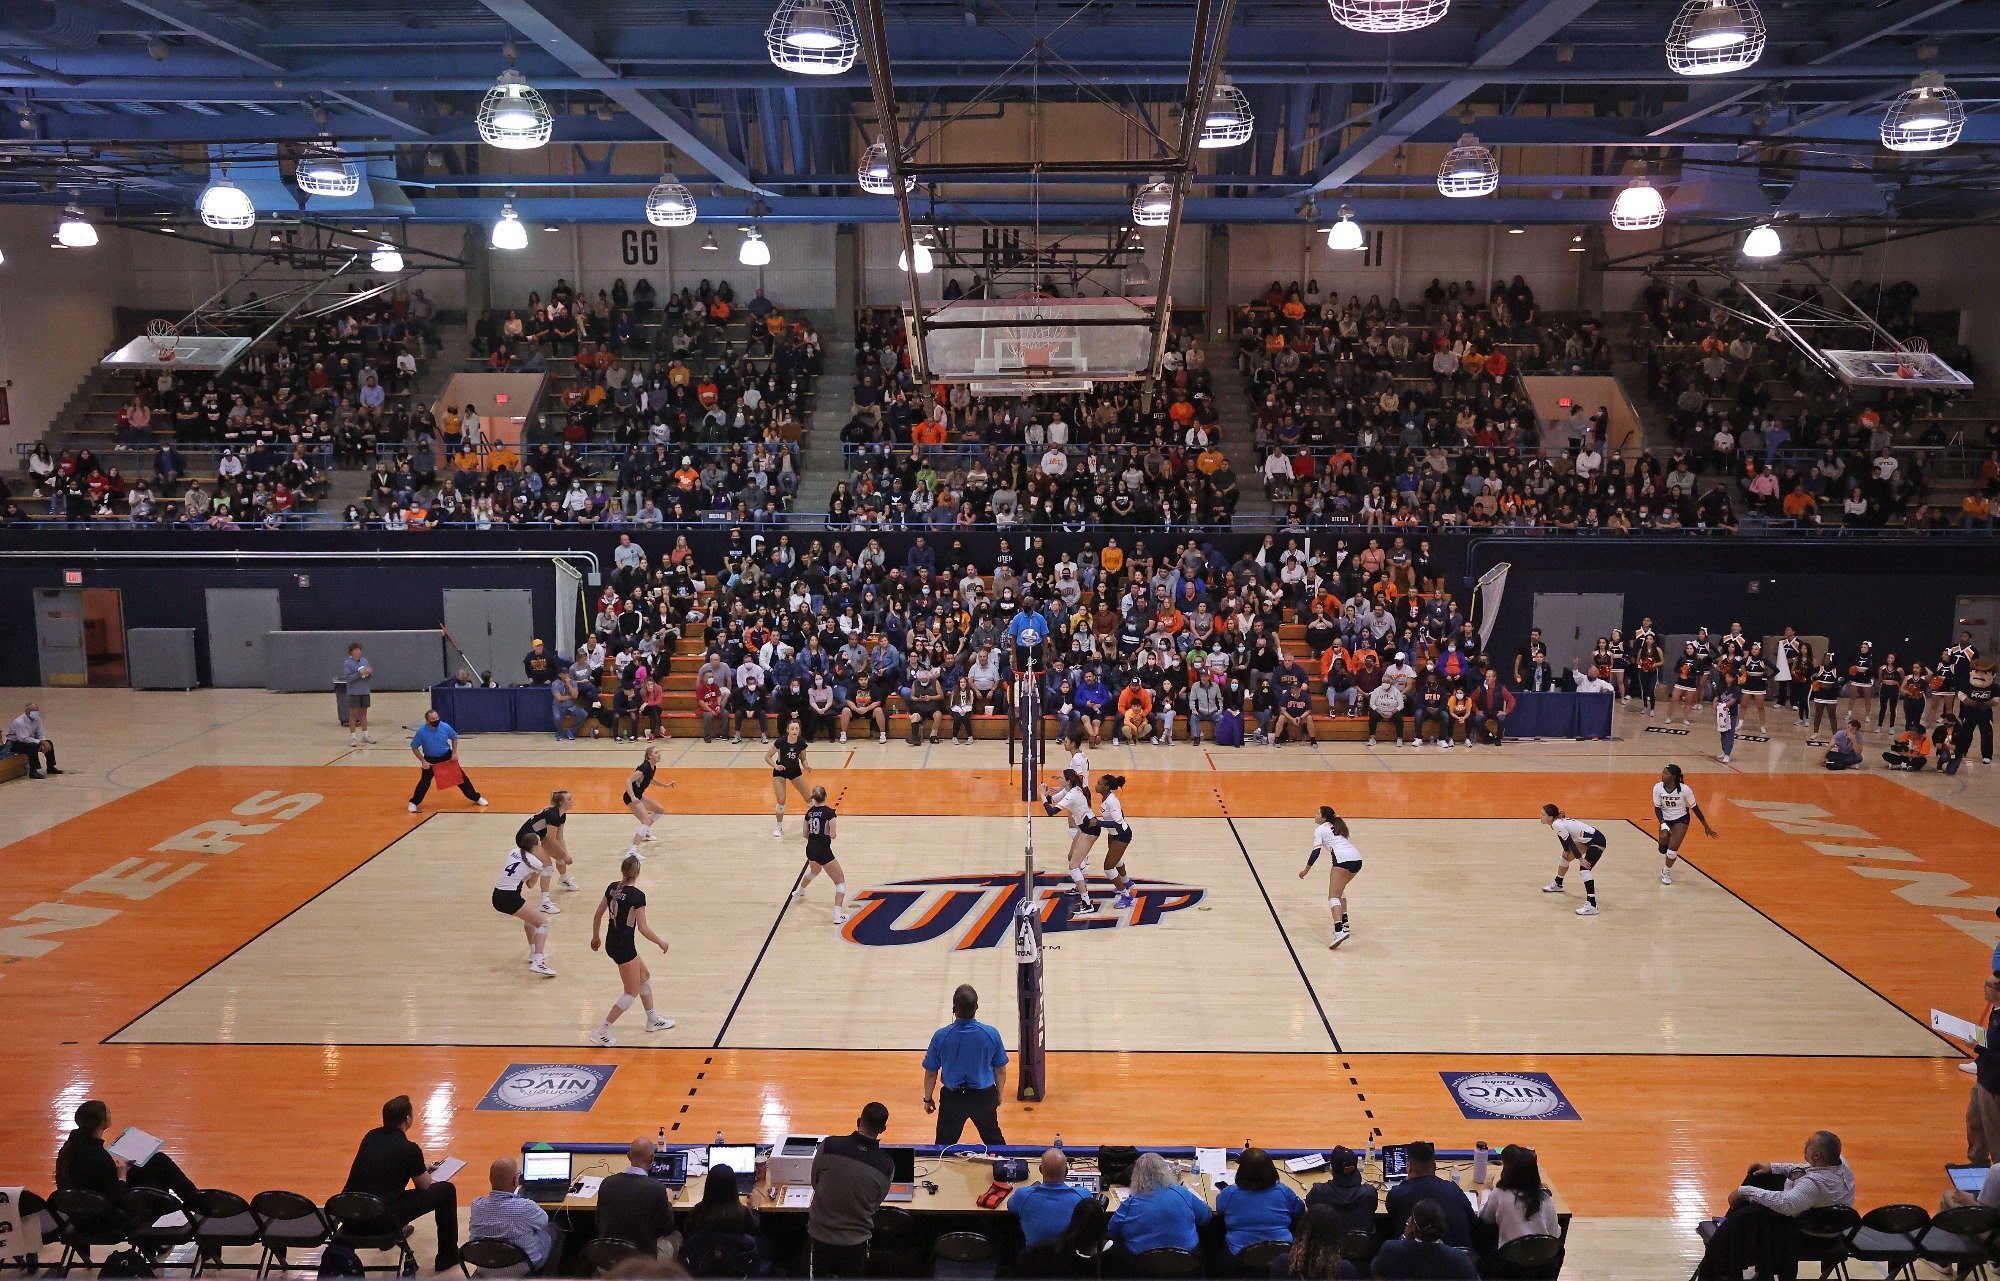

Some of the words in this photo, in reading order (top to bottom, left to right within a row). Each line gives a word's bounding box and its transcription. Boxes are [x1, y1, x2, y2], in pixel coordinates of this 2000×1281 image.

[622, 229, 658, 265] GG
[982, 228, 1023, 268] HH
[1424, 693, 1441, 701] UTEP
[786, 752, 796, 760] 15
[808, 818, 821, 834] 19
[0, 790, 324, 959] NERS
[504, 861, 521, 877] 4
[841, 871, 1206, 950] UTEP
[510, 1079, 591, 1089] NIVC
[1465, 1086, 1547, 1097] NIVC
